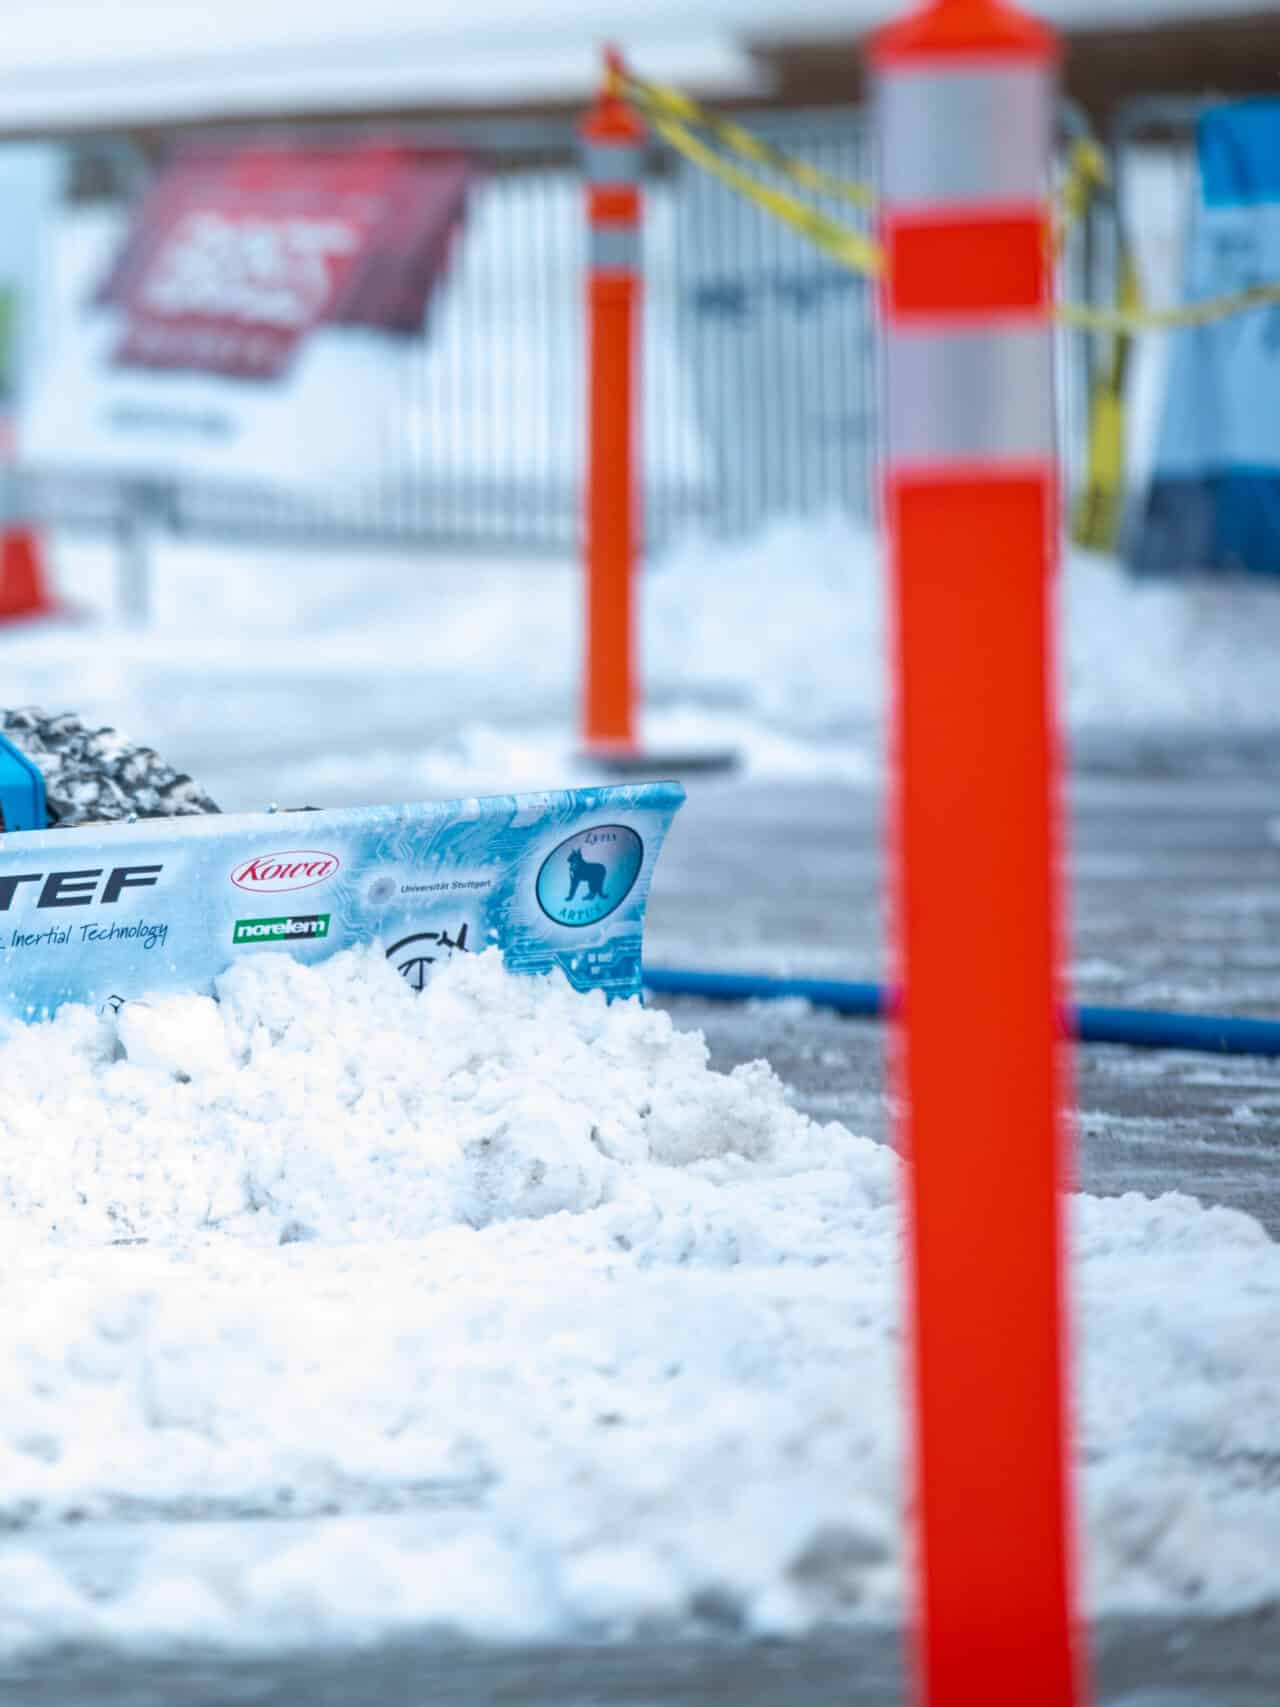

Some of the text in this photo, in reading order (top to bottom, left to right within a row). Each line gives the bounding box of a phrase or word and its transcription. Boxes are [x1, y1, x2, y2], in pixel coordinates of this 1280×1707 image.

[237, 859, 333, 882] Kowa
[401, 879, 492, 894] Universität Stuttgart
[10, 925, 73, 948] Inertial
[79, 919, 168, 950] Technology
[237, 918, 326, 938] norelem
